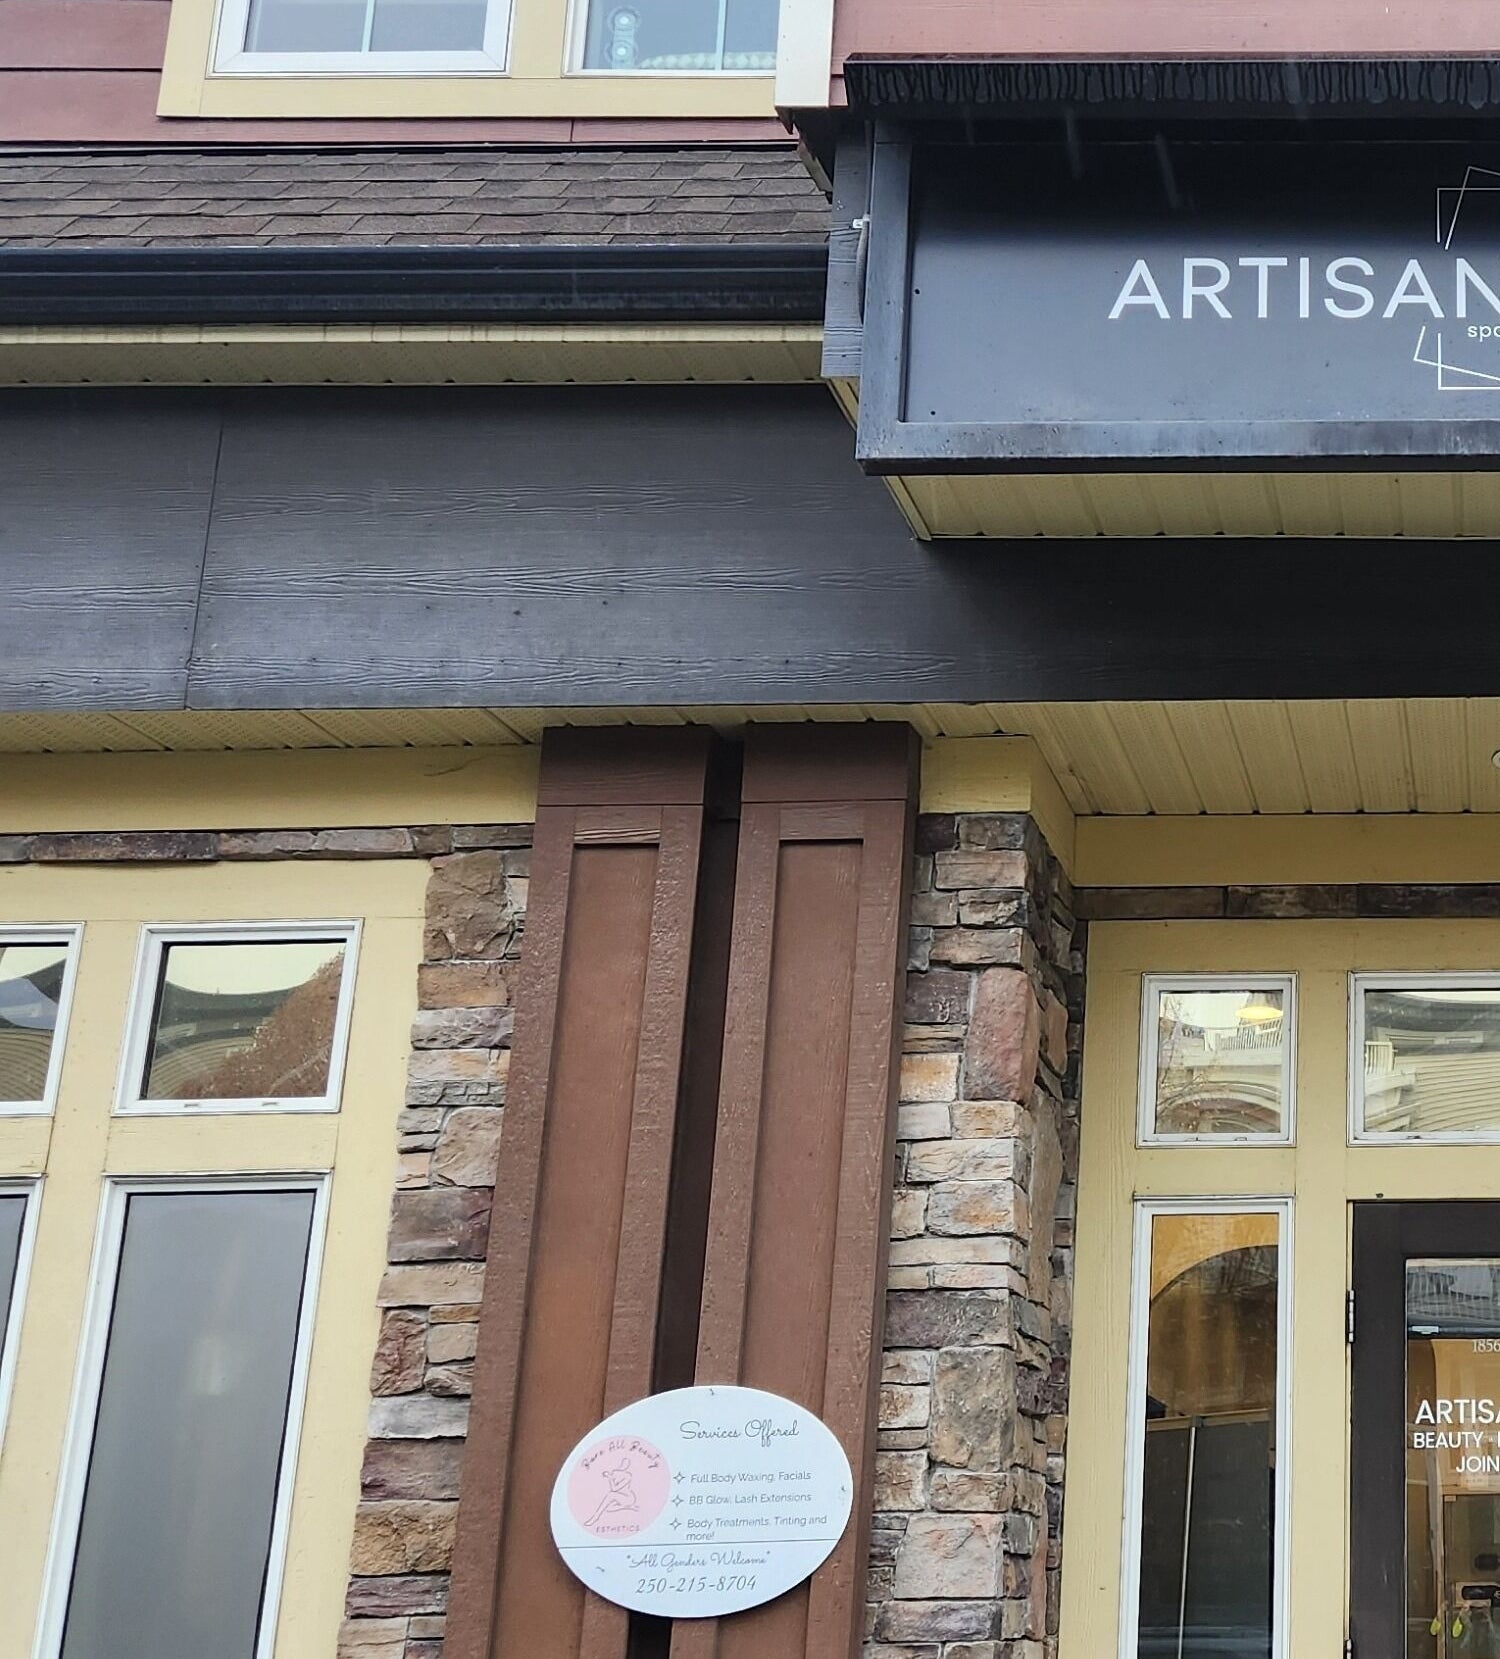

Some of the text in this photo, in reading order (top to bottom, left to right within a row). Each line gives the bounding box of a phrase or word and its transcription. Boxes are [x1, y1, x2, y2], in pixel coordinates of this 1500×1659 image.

[679, 1418, 800, 1448] Services Offered
[1413, 1431, 1484, 1449] BEAUTY
[608, 1439, 626, 1452] All
[690, 1473, 709, 1484] Full
[711, 1473, 737, 1485] Body
[778, 1471, 812, 1481] Facials
[688, 1495, 703, 1505] BB
[734, 1494, 758, 1504] Lash
[760, 1492, 812, 1503] Extensions
[596, 1524, 641, 1533] ESTHETICS
[687, 1518, 713, 1530] Body
[774, 1515, 807, 1527] Tinting
[808, 1514, 828, 1525] and
[686, 1531, 715, 1542] more!
[660, 1552, 708, 1573] Genders
[634, 1574, 758, 1594] 250-215-8704
